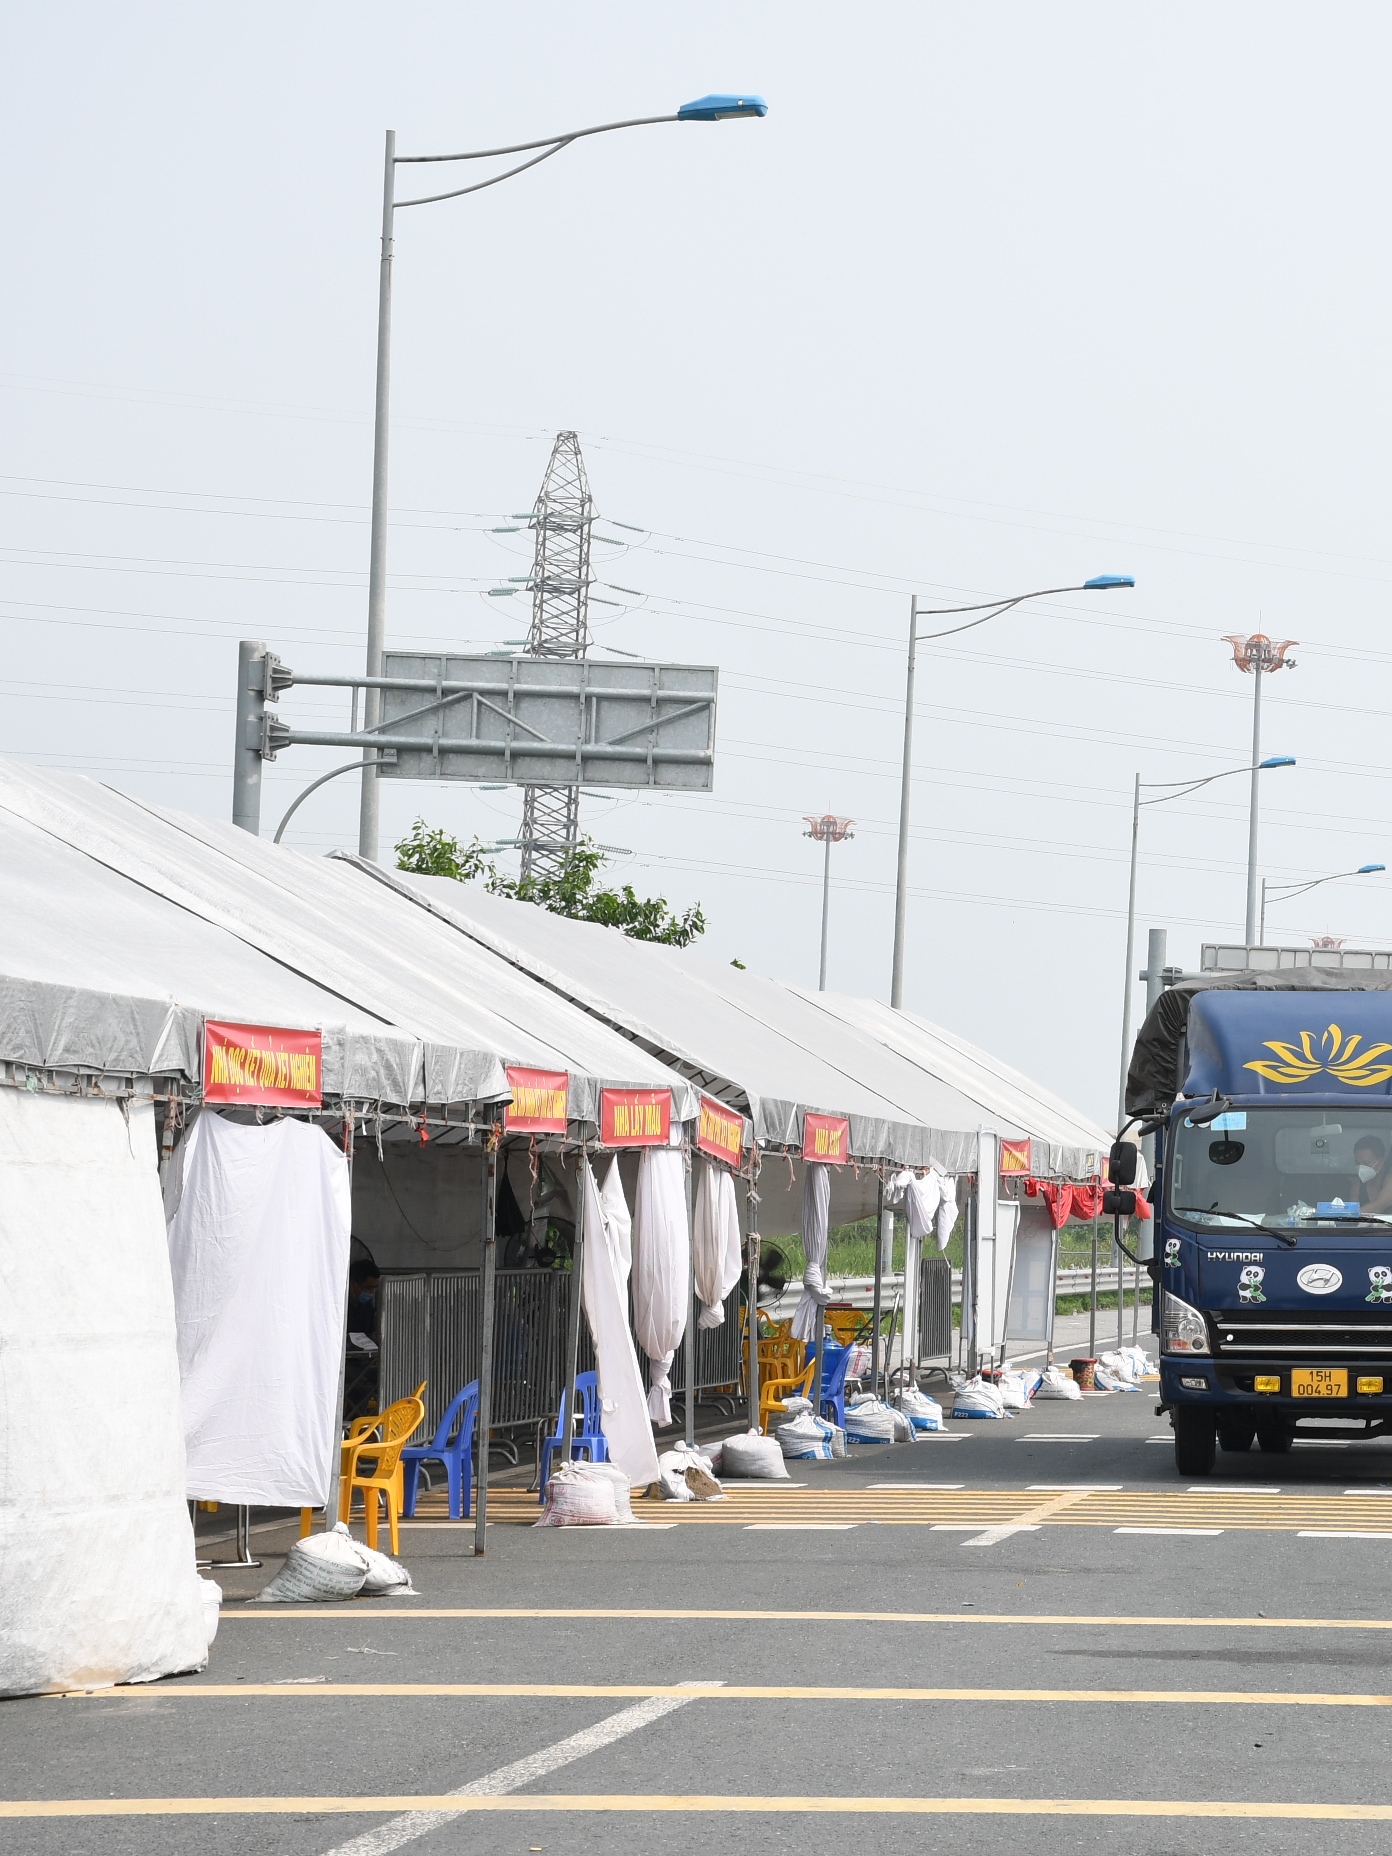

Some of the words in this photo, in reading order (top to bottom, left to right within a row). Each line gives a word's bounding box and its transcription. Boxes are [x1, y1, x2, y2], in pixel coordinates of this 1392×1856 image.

[614, 1098, 630, 1137] NHÀ
[630, 1093, 644, 1136] LẤY
[645, 1092, 661, 1136] MẪU
[1207, 1251, 1264, 1263] HYUNDAI
[1309, 1370, 1332, 1383] 15H
[1297, 1383, 1342, 1396] 004.97
